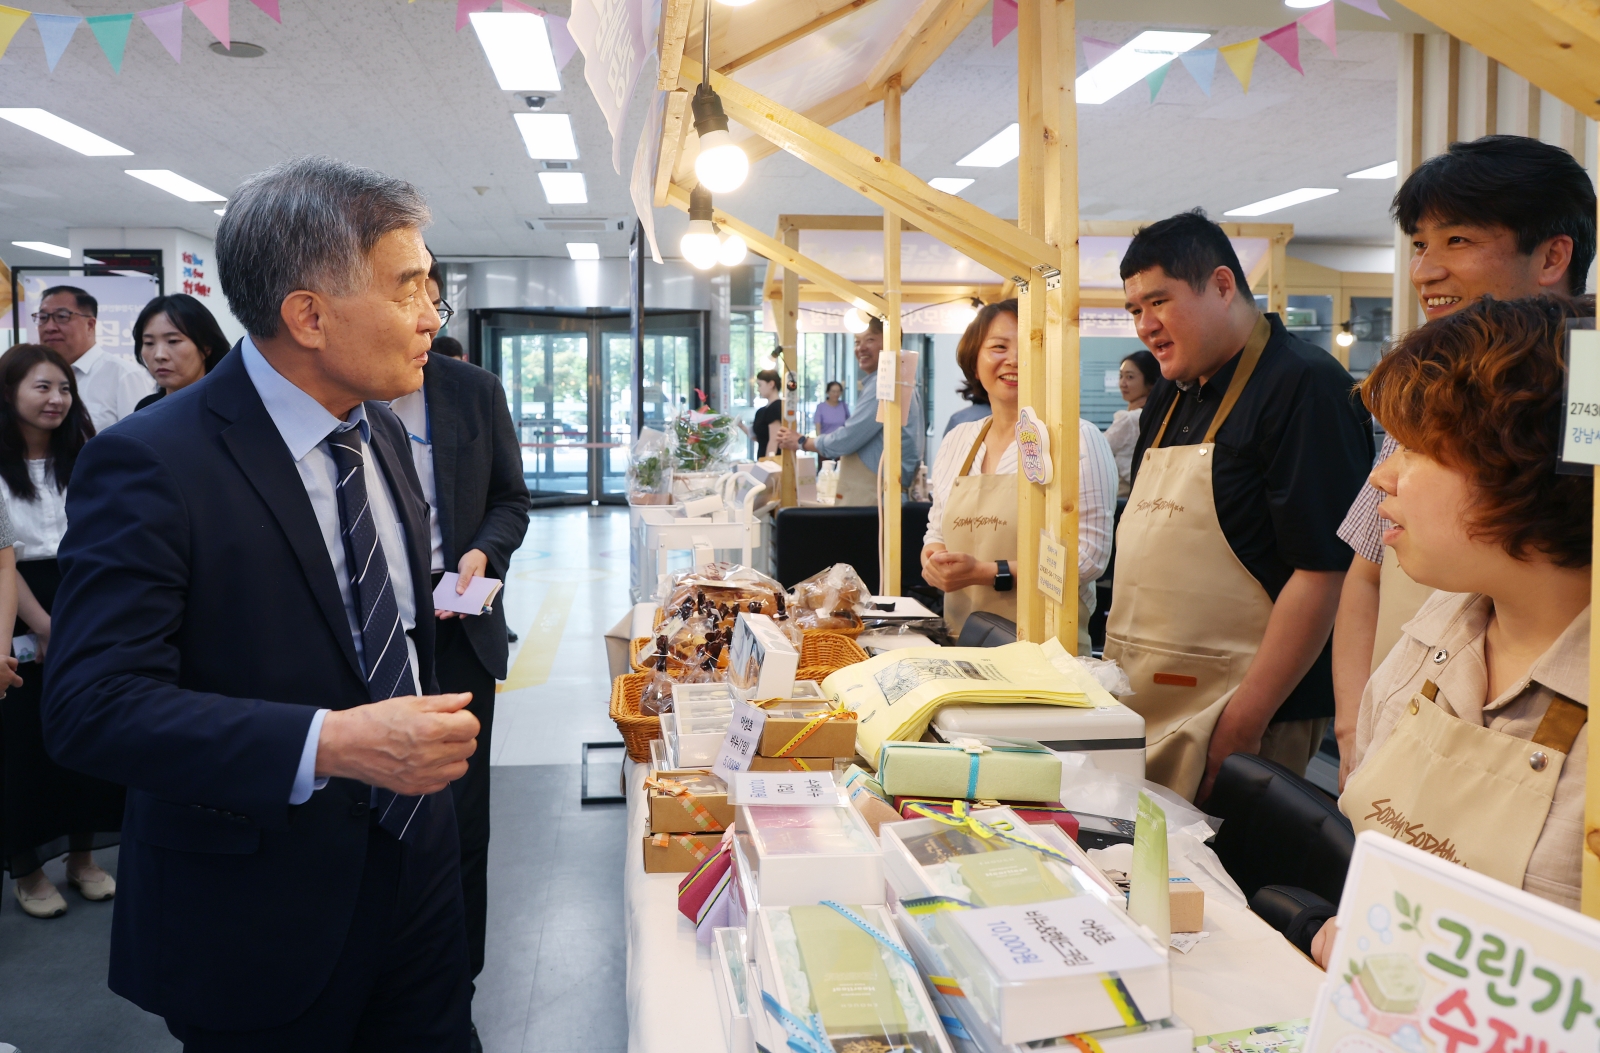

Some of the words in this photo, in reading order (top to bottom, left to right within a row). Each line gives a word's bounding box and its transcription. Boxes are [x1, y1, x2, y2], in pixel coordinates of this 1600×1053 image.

[1570, 402, 1600, 417] 2743
[987, 920, 1043, 965] 10,000원
[1024, 910, 1095, 967] 비누&핸드크림
[1080, 918, 1116, 946] 어성초
[1426, 917, 1600, 1031] 그린가
